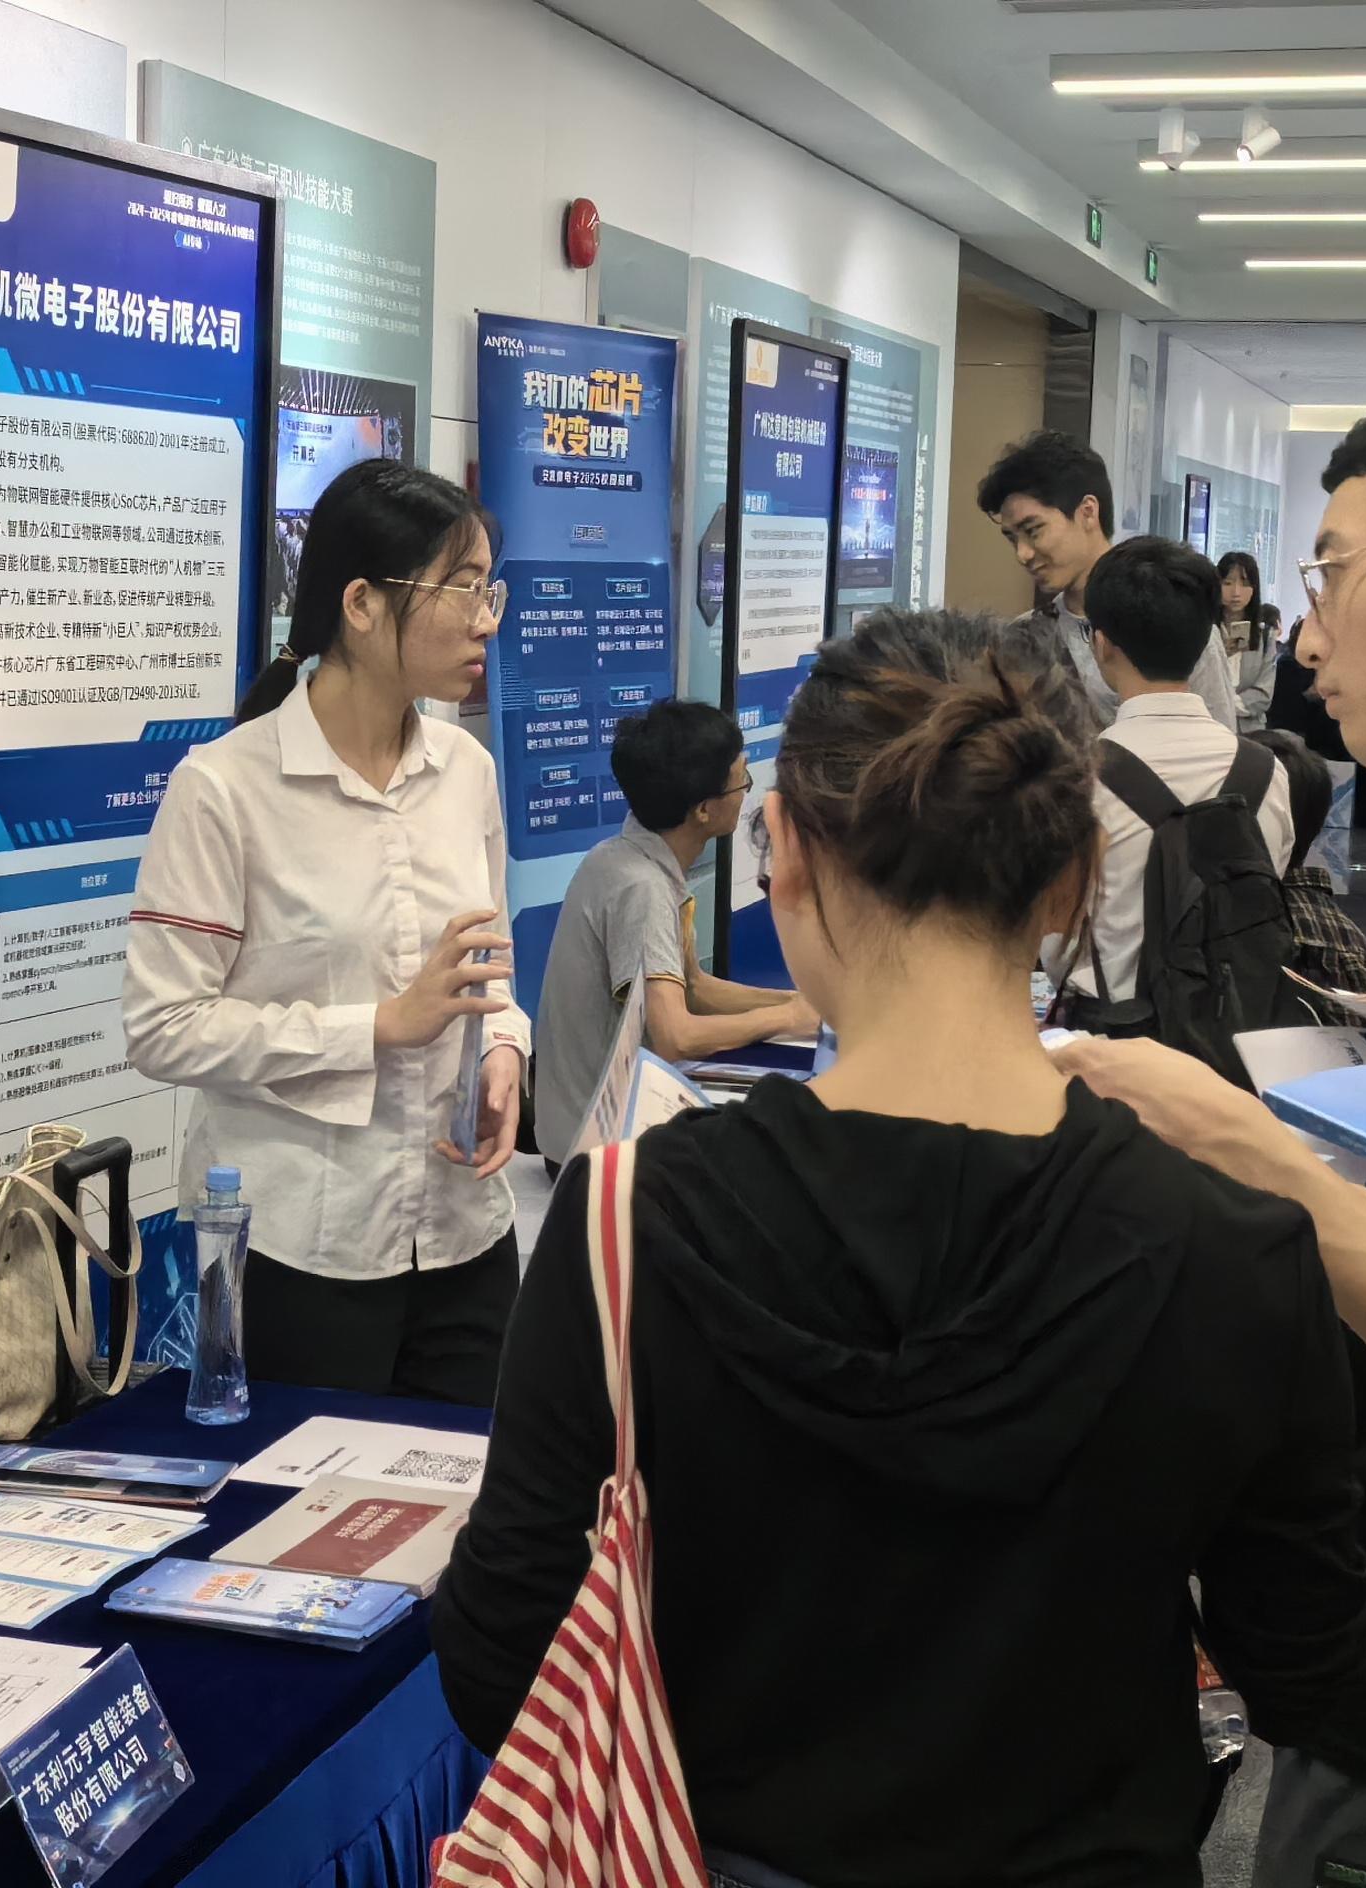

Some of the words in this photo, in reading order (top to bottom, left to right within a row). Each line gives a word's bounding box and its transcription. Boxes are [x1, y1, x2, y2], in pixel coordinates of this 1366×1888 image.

[484, 335, 524, 350] ANYKA
[524, 369, 643, 417] 我们的芯片
[542, 414, 630, 460] 改变世界
[542, 469, 634, 488] 安凯微电子2025校园招聘
[776, 451, 803, 479] 有限公司
[17, 1683, 151, 1820] 广东利元亨智能装备
[53, 1734, 149, 1838] 股份有限公司
